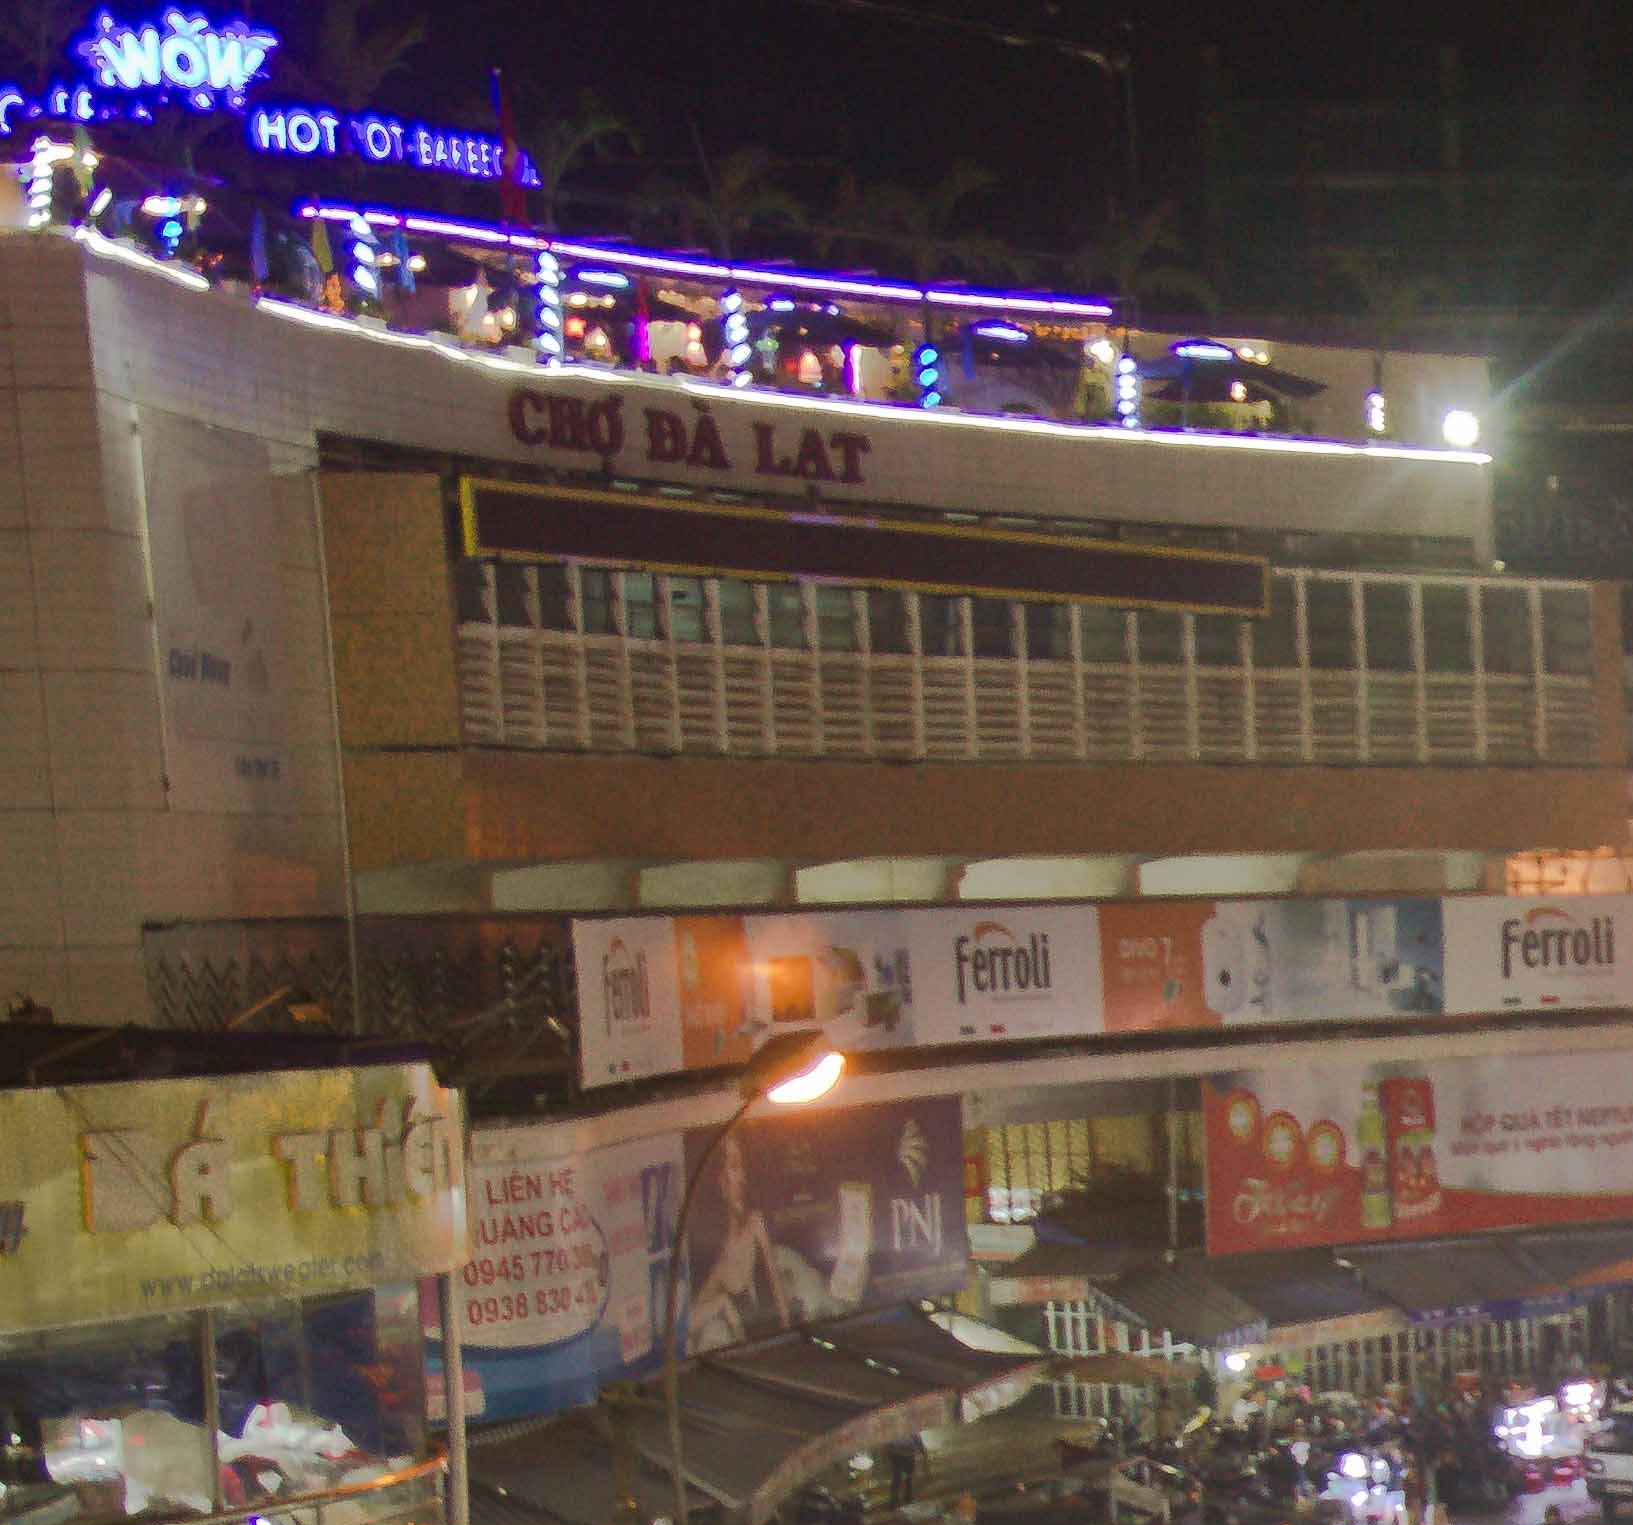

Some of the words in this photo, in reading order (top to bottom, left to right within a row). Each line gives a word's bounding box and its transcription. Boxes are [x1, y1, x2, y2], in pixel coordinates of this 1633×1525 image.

[258, 113, 340, 153] HOT
[1502, 915, 1616, 980] Ferroli
[953, 932, 1051, 1005] Ferroli
[486, 1167, 542, 1206] LIÊN
[463, 1255, 527, 1287] 0945
[531, 1249, 569, 1279] 770
[467, 1293, 529, 1327] 0938
